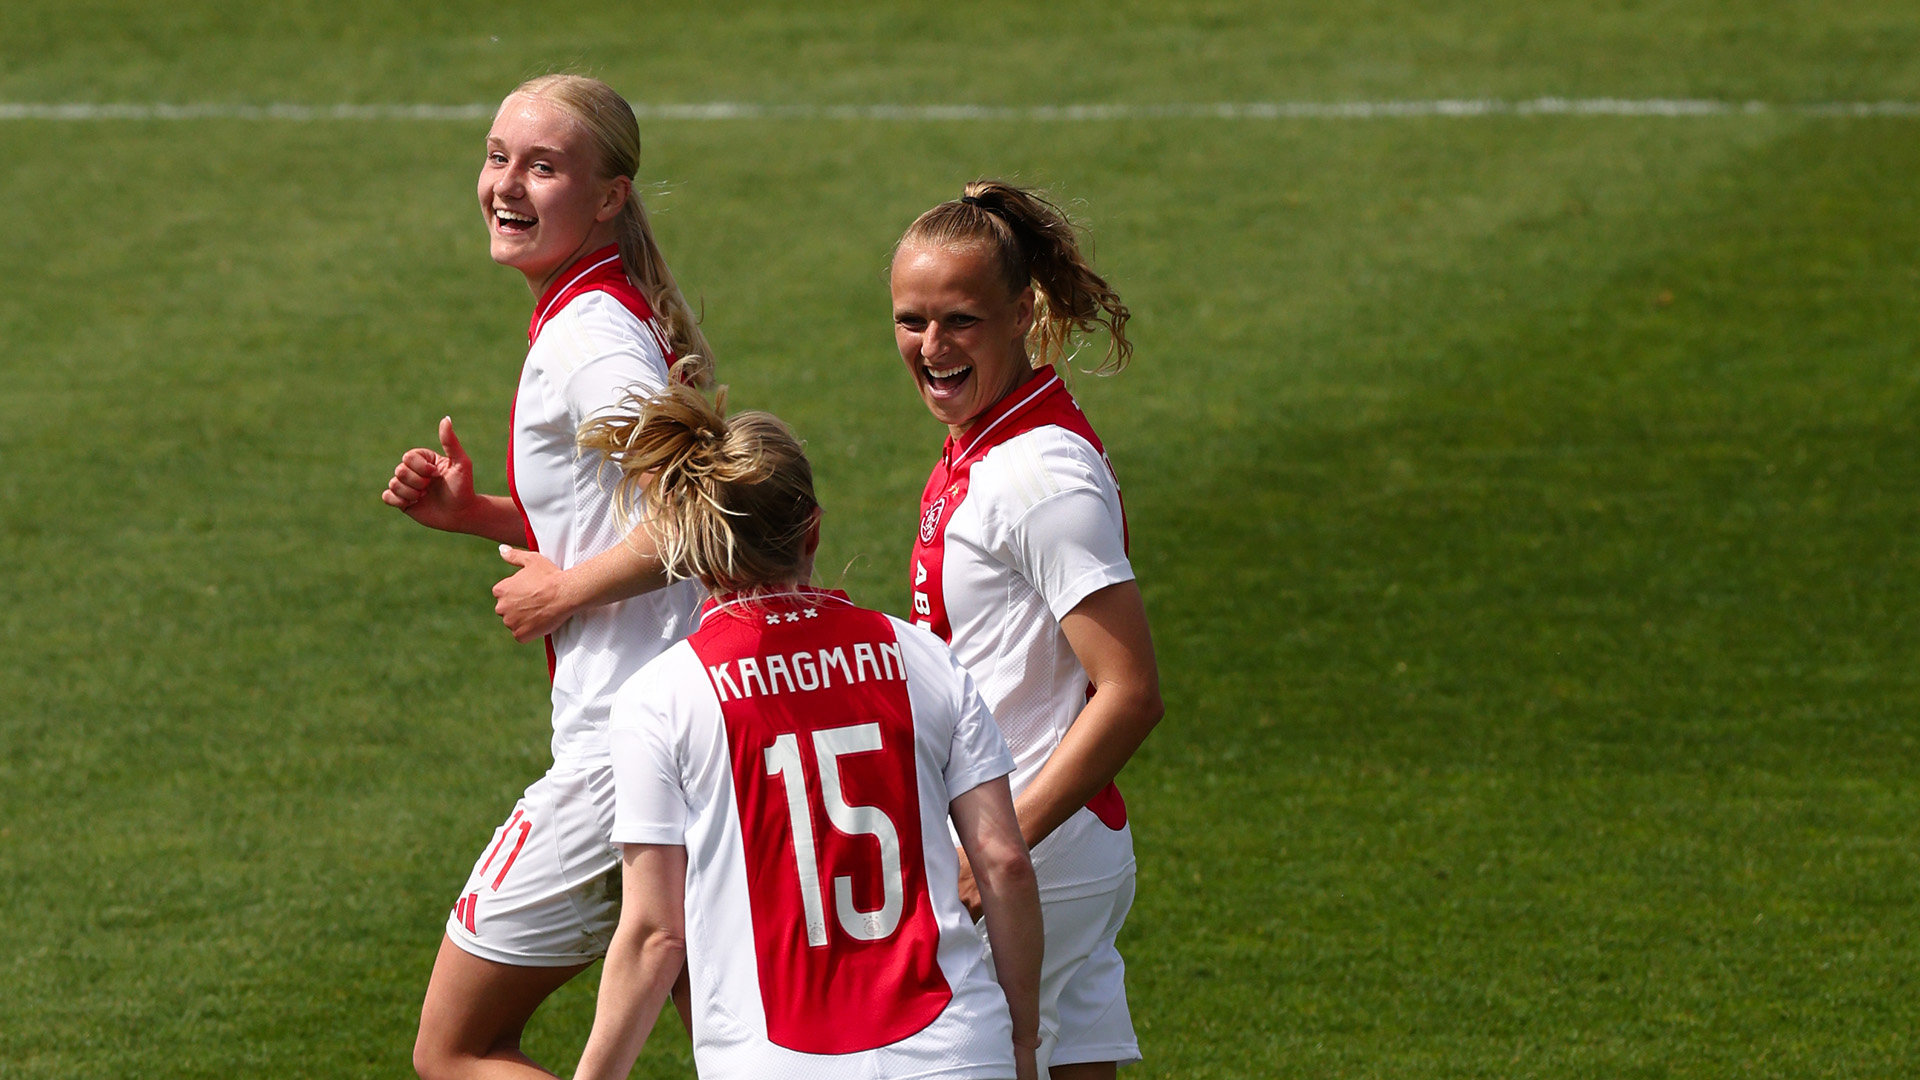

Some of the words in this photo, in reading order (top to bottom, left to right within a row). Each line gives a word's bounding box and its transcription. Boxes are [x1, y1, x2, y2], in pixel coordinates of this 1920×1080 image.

[709, 641, 908, 701] KAAGMAN
[479, 809, 532, 892] 11
[763, 722, 904, 947] 15
